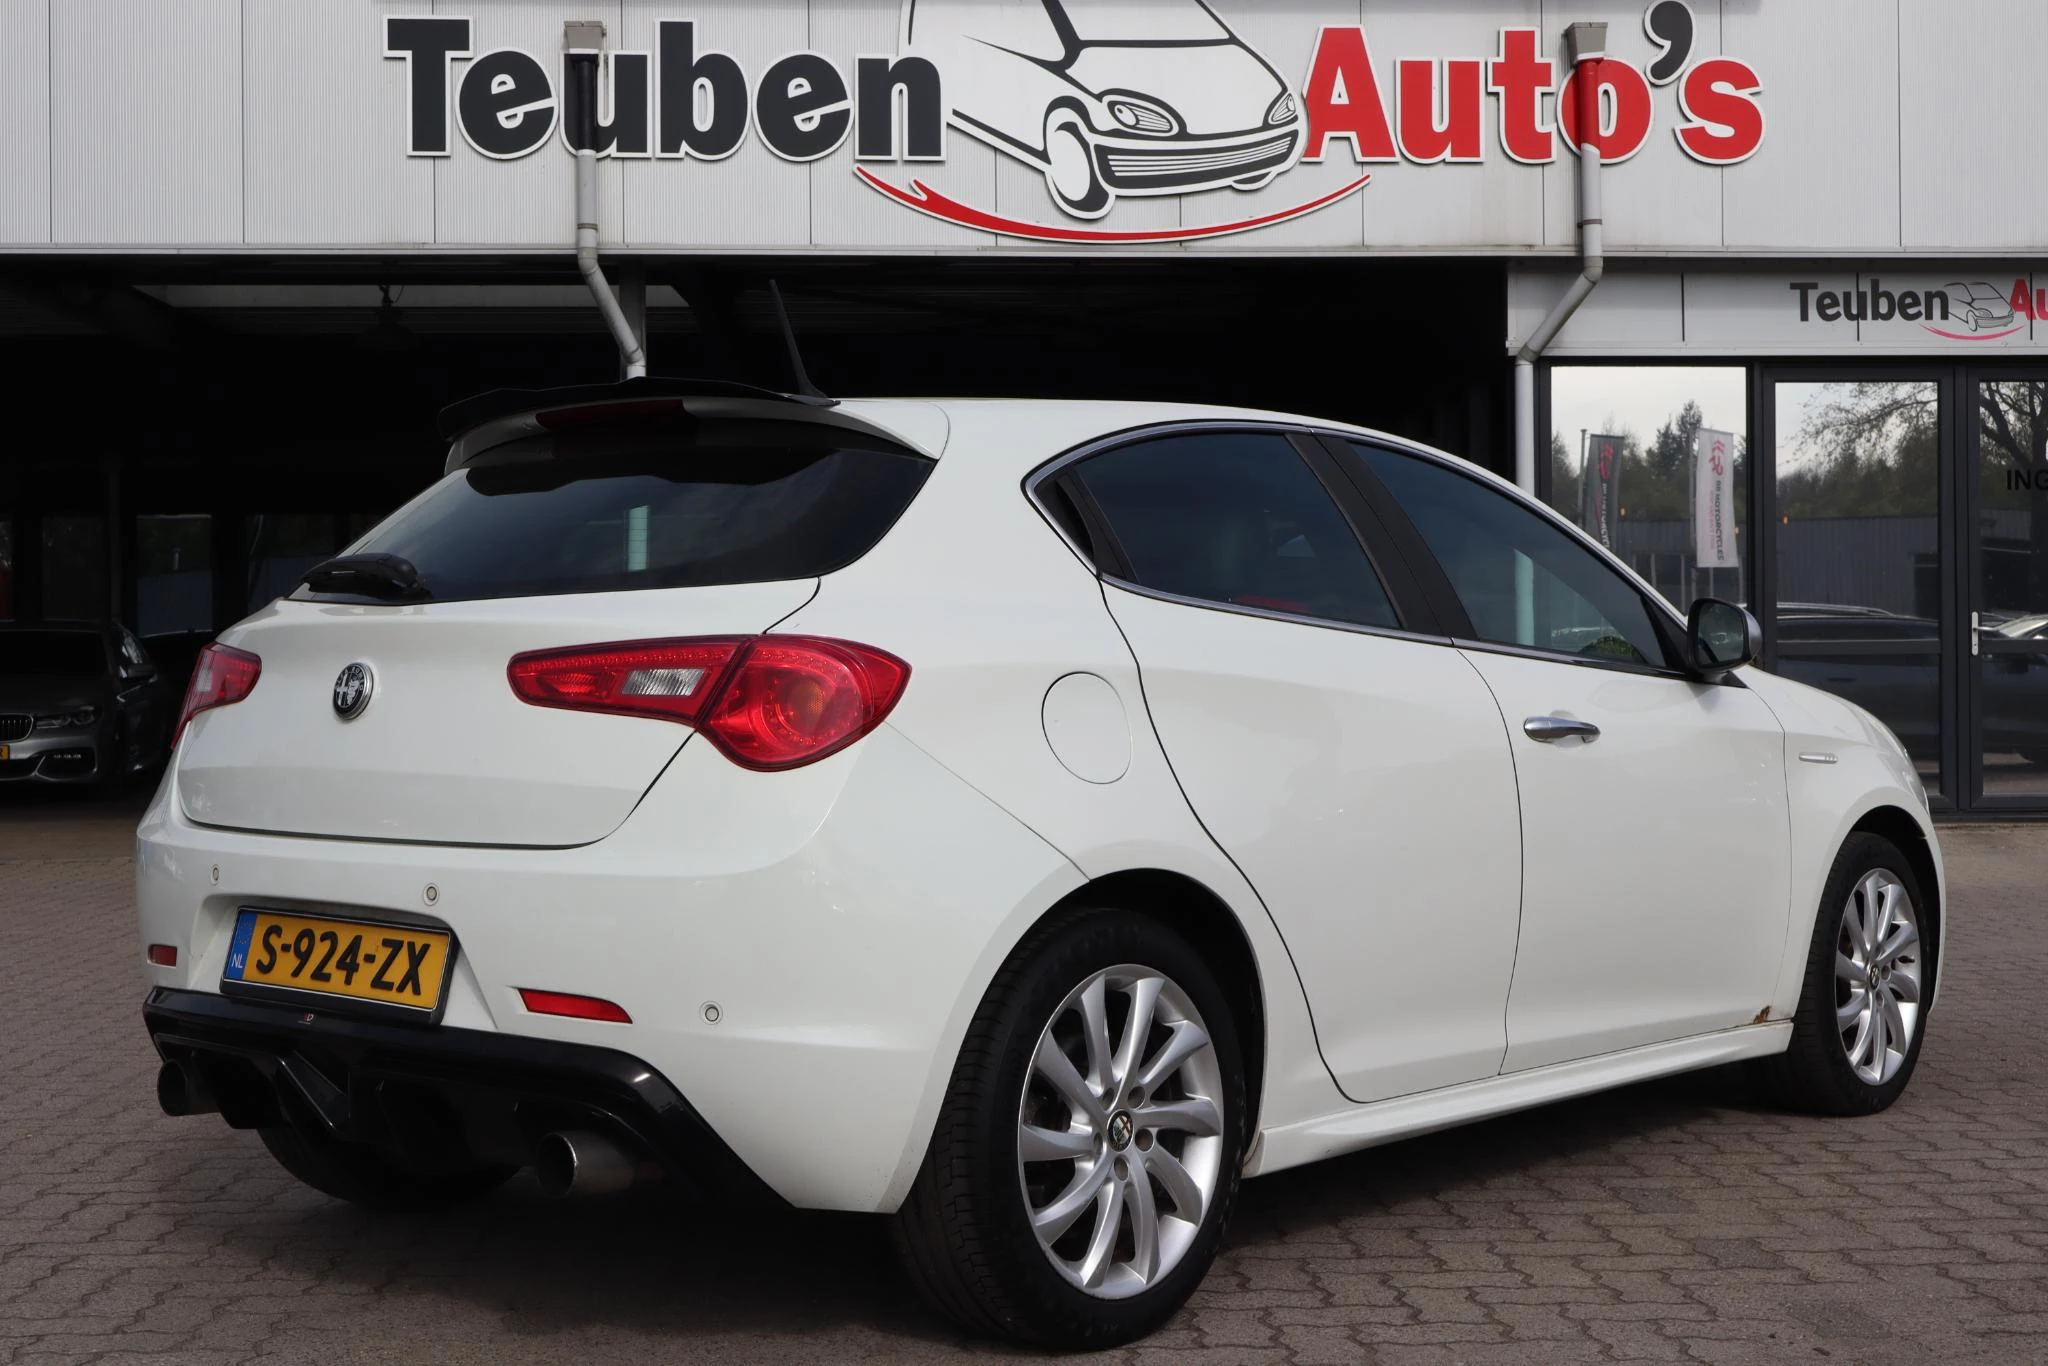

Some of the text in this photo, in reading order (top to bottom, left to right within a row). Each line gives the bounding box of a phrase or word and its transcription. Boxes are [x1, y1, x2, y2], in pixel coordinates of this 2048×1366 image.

[386, 0, 1765, 163] Teuben Auto's
[1789, 279, 1949, 322] Teuben
[231, 953, 243, 969] NL
[255, 924, 431, 996] S-924-ZX
